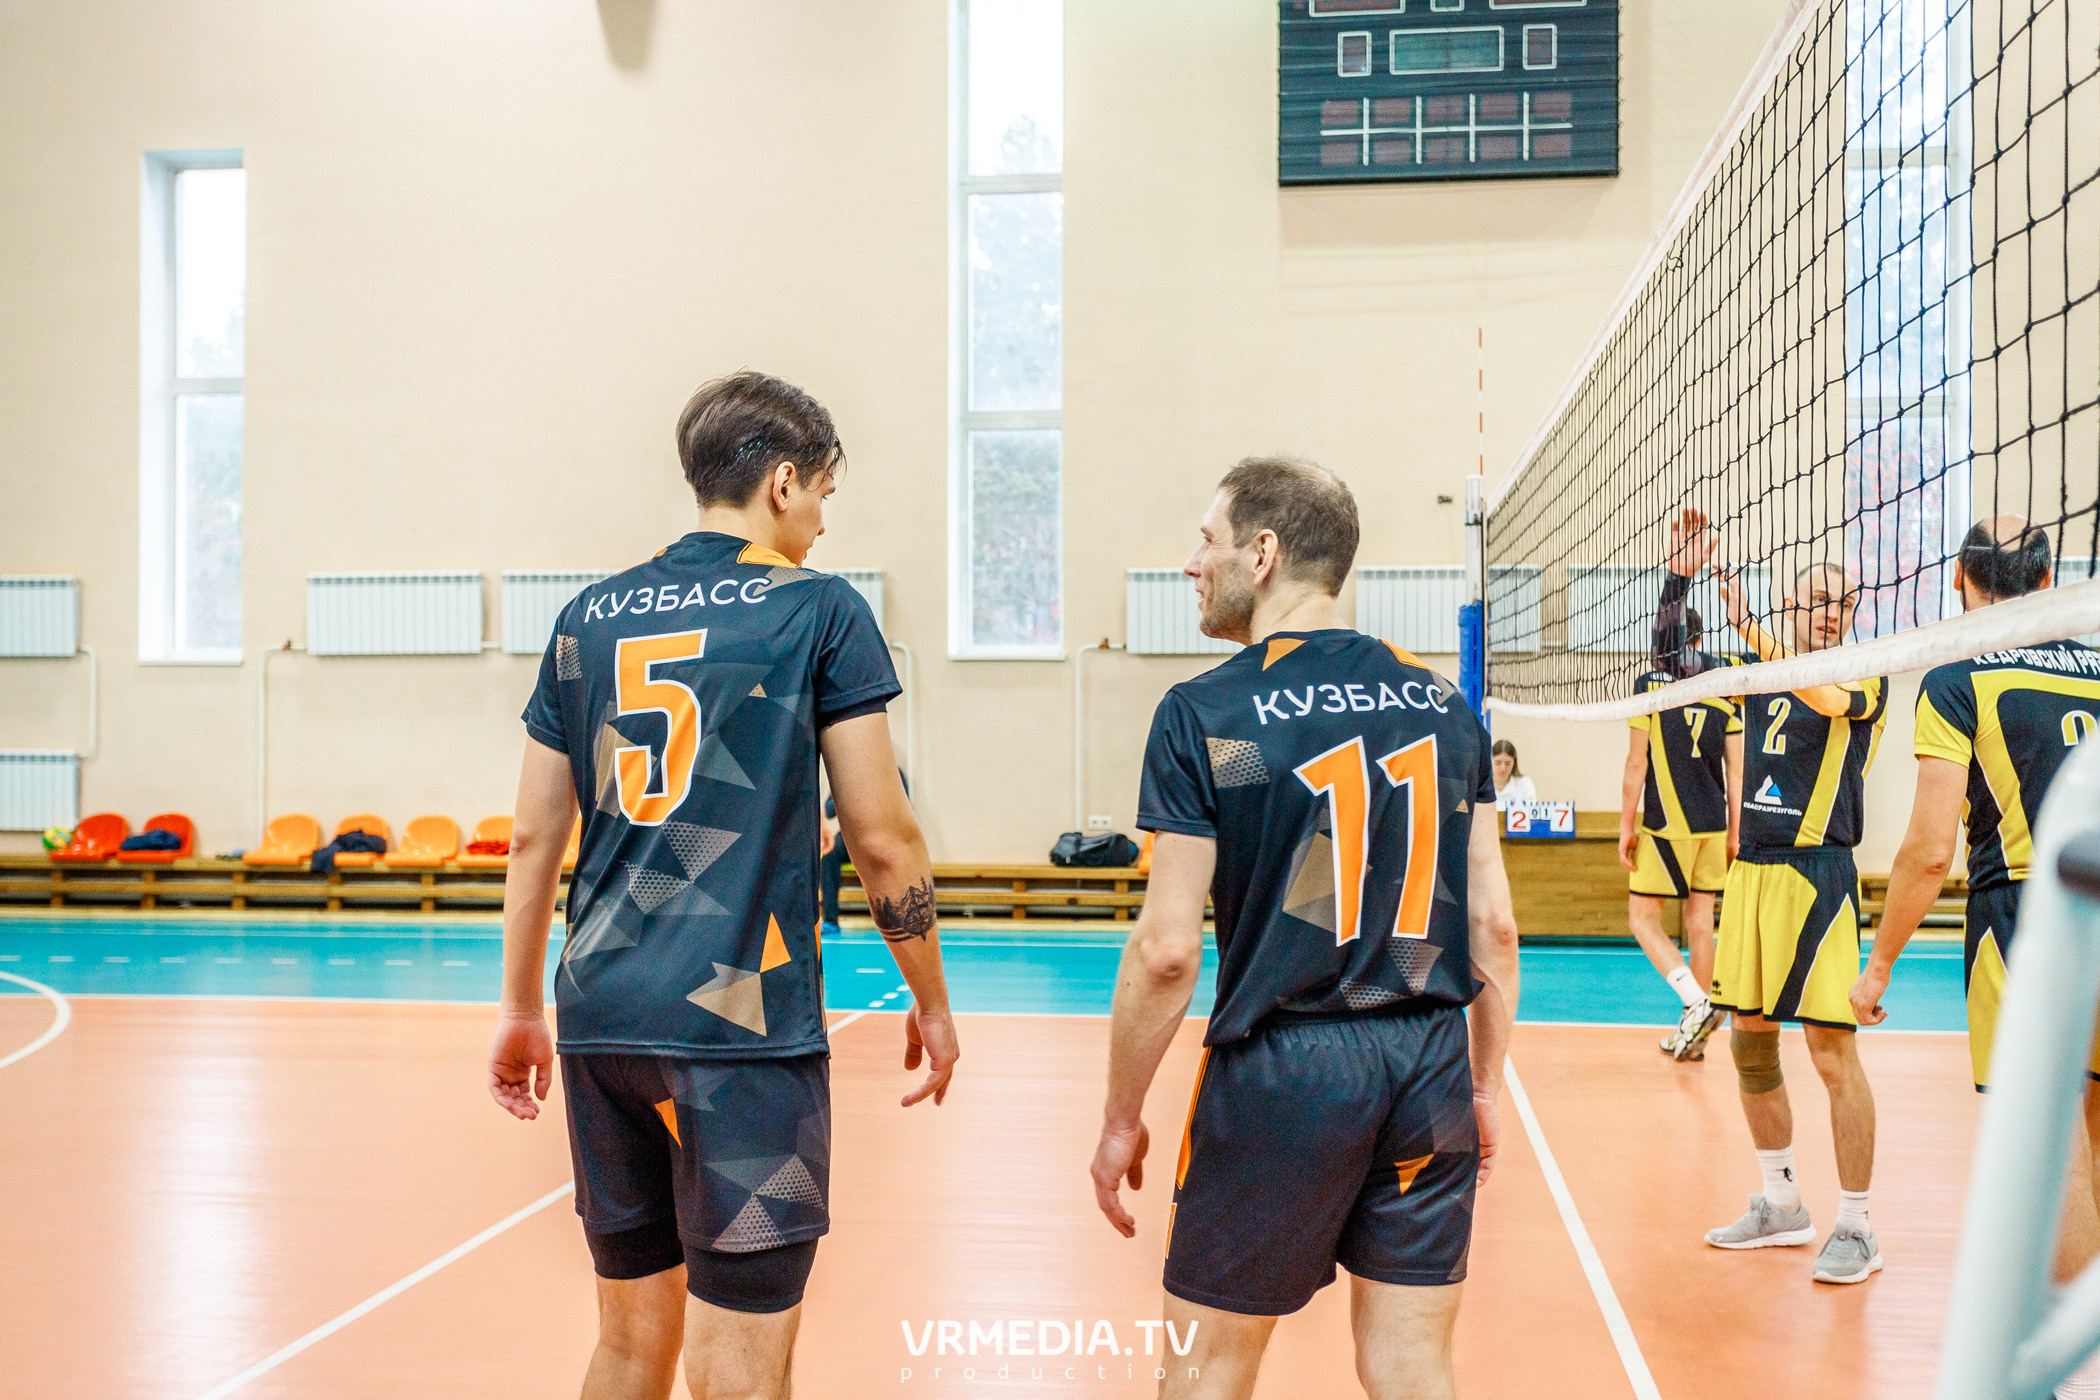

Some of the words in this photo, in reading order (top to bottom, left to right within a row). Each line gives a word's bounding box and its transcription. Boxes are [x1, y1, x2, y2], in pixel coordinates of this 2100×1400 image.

[584, 577, 773, 623] КУЗБАСС
[1972, 644, 2081, 673] КЕДРОВСКИЙ
[615, 628, 708, 826] 5
[1253, 681, 1449, 725] КУЗБАСС
[1762, 697, 1791, 755] 2
[1683, 706, 1707, 758] 7
[1292, 733, 1441, 947] 11
[1512, 810, 1527, 829] 2
[1555, 809, 1569, 827] 7
